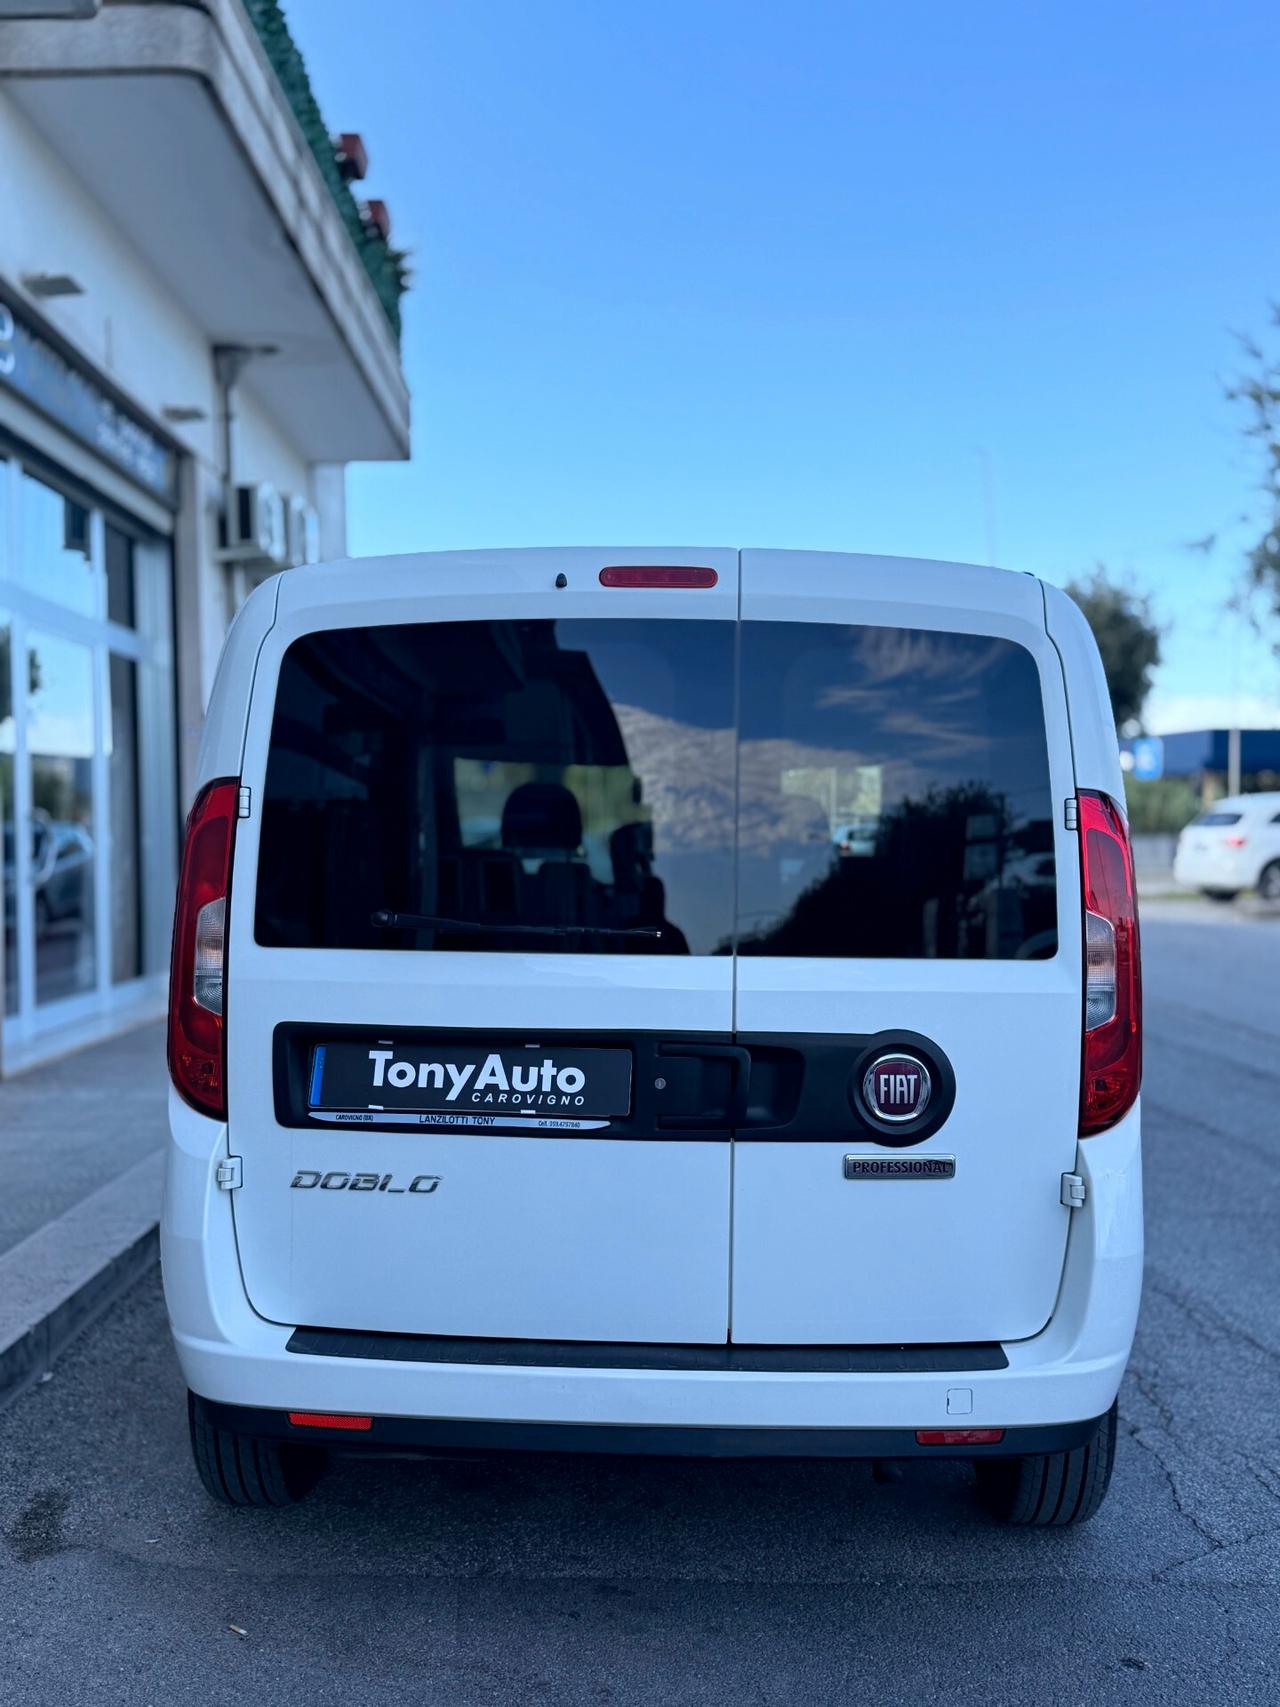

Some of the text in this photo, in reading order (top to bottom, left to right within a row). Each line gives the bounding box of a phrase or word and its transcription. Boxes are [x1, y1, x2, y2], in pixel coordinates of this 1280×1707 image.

[368, 1050, 586, 1101] TonyAuto
[879, 1074, 918, 1104] FIAT
[471, 1092, 585, 1106] CAROVIGNO
[335, 1113, 362, 1121] CAROVIGNO
[419, 1115, 496, 1125] LANZILOTTI TONY
[852, 1161, 949, 1174] PROFESSIONAL
